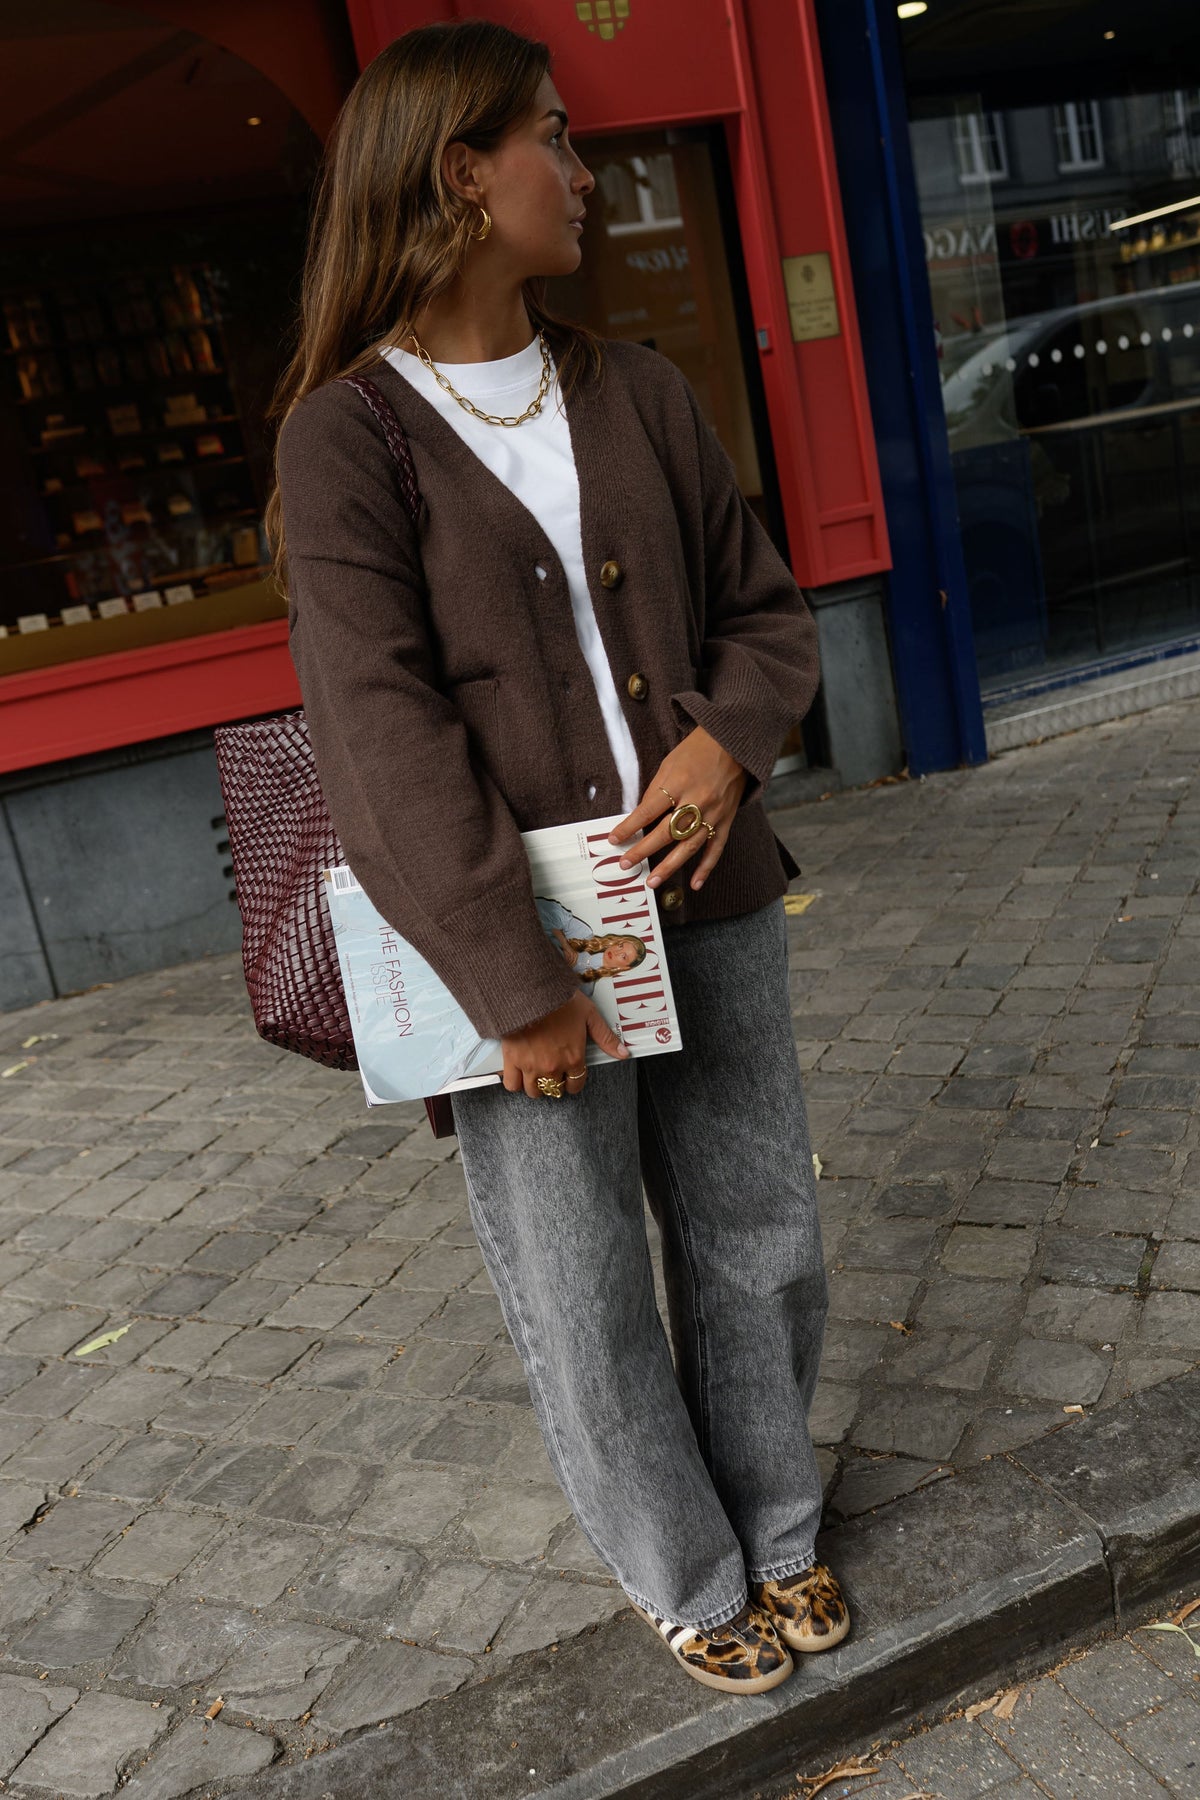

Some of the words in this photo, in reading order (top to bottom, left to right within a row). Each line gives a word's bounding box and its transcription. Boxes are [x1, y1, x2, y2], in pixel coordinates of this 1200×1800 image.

[379, 926, 398, 955] THE
[585, 829, 670, 1047] LOFFIEL
[370, 962, 392, 1006] ISSUE
[385, 959, 414, 1038] FASHION
